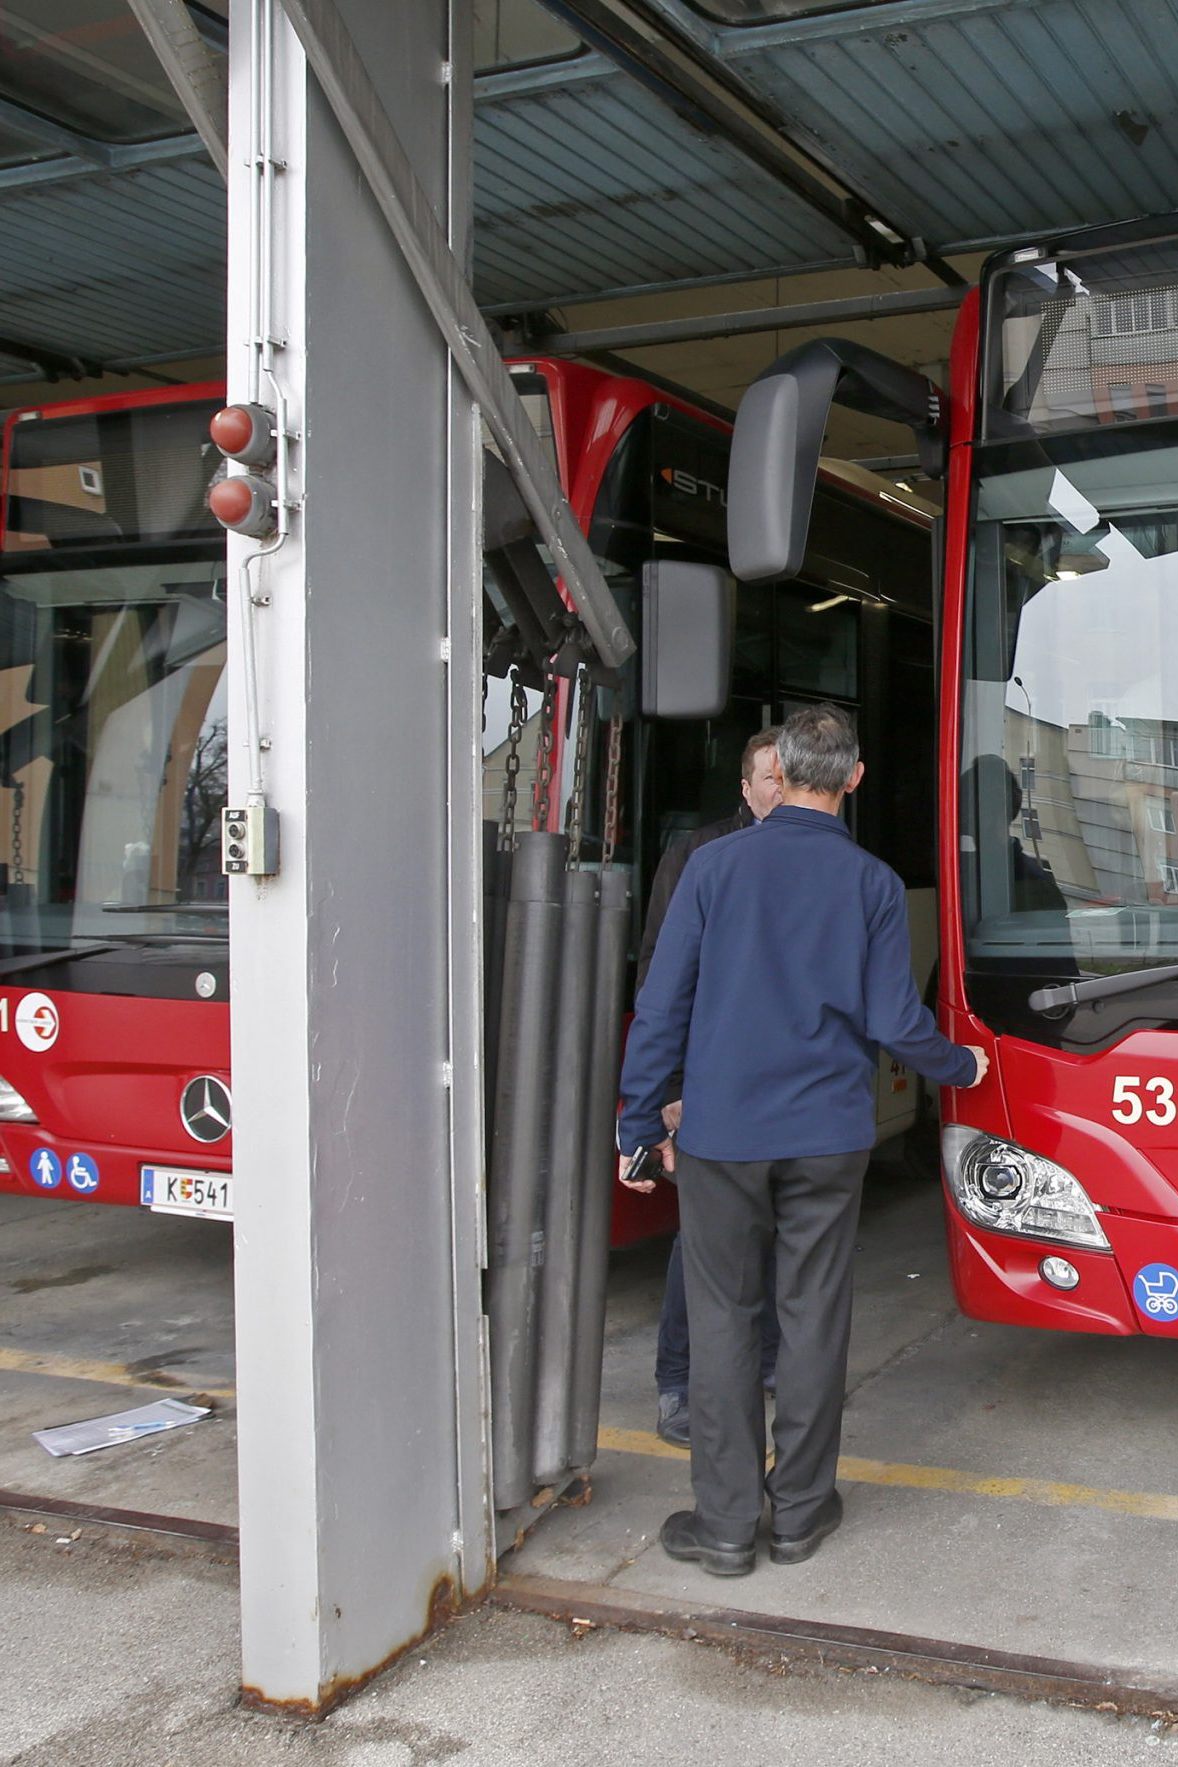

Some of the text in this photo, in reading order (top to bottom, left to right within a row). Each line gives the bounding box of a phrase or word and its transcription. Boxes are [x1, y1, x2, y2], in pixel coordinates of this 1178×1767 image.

[1111, 1074, 1177, 1127] 53
[167, 1176, 229, 1206] K 541
